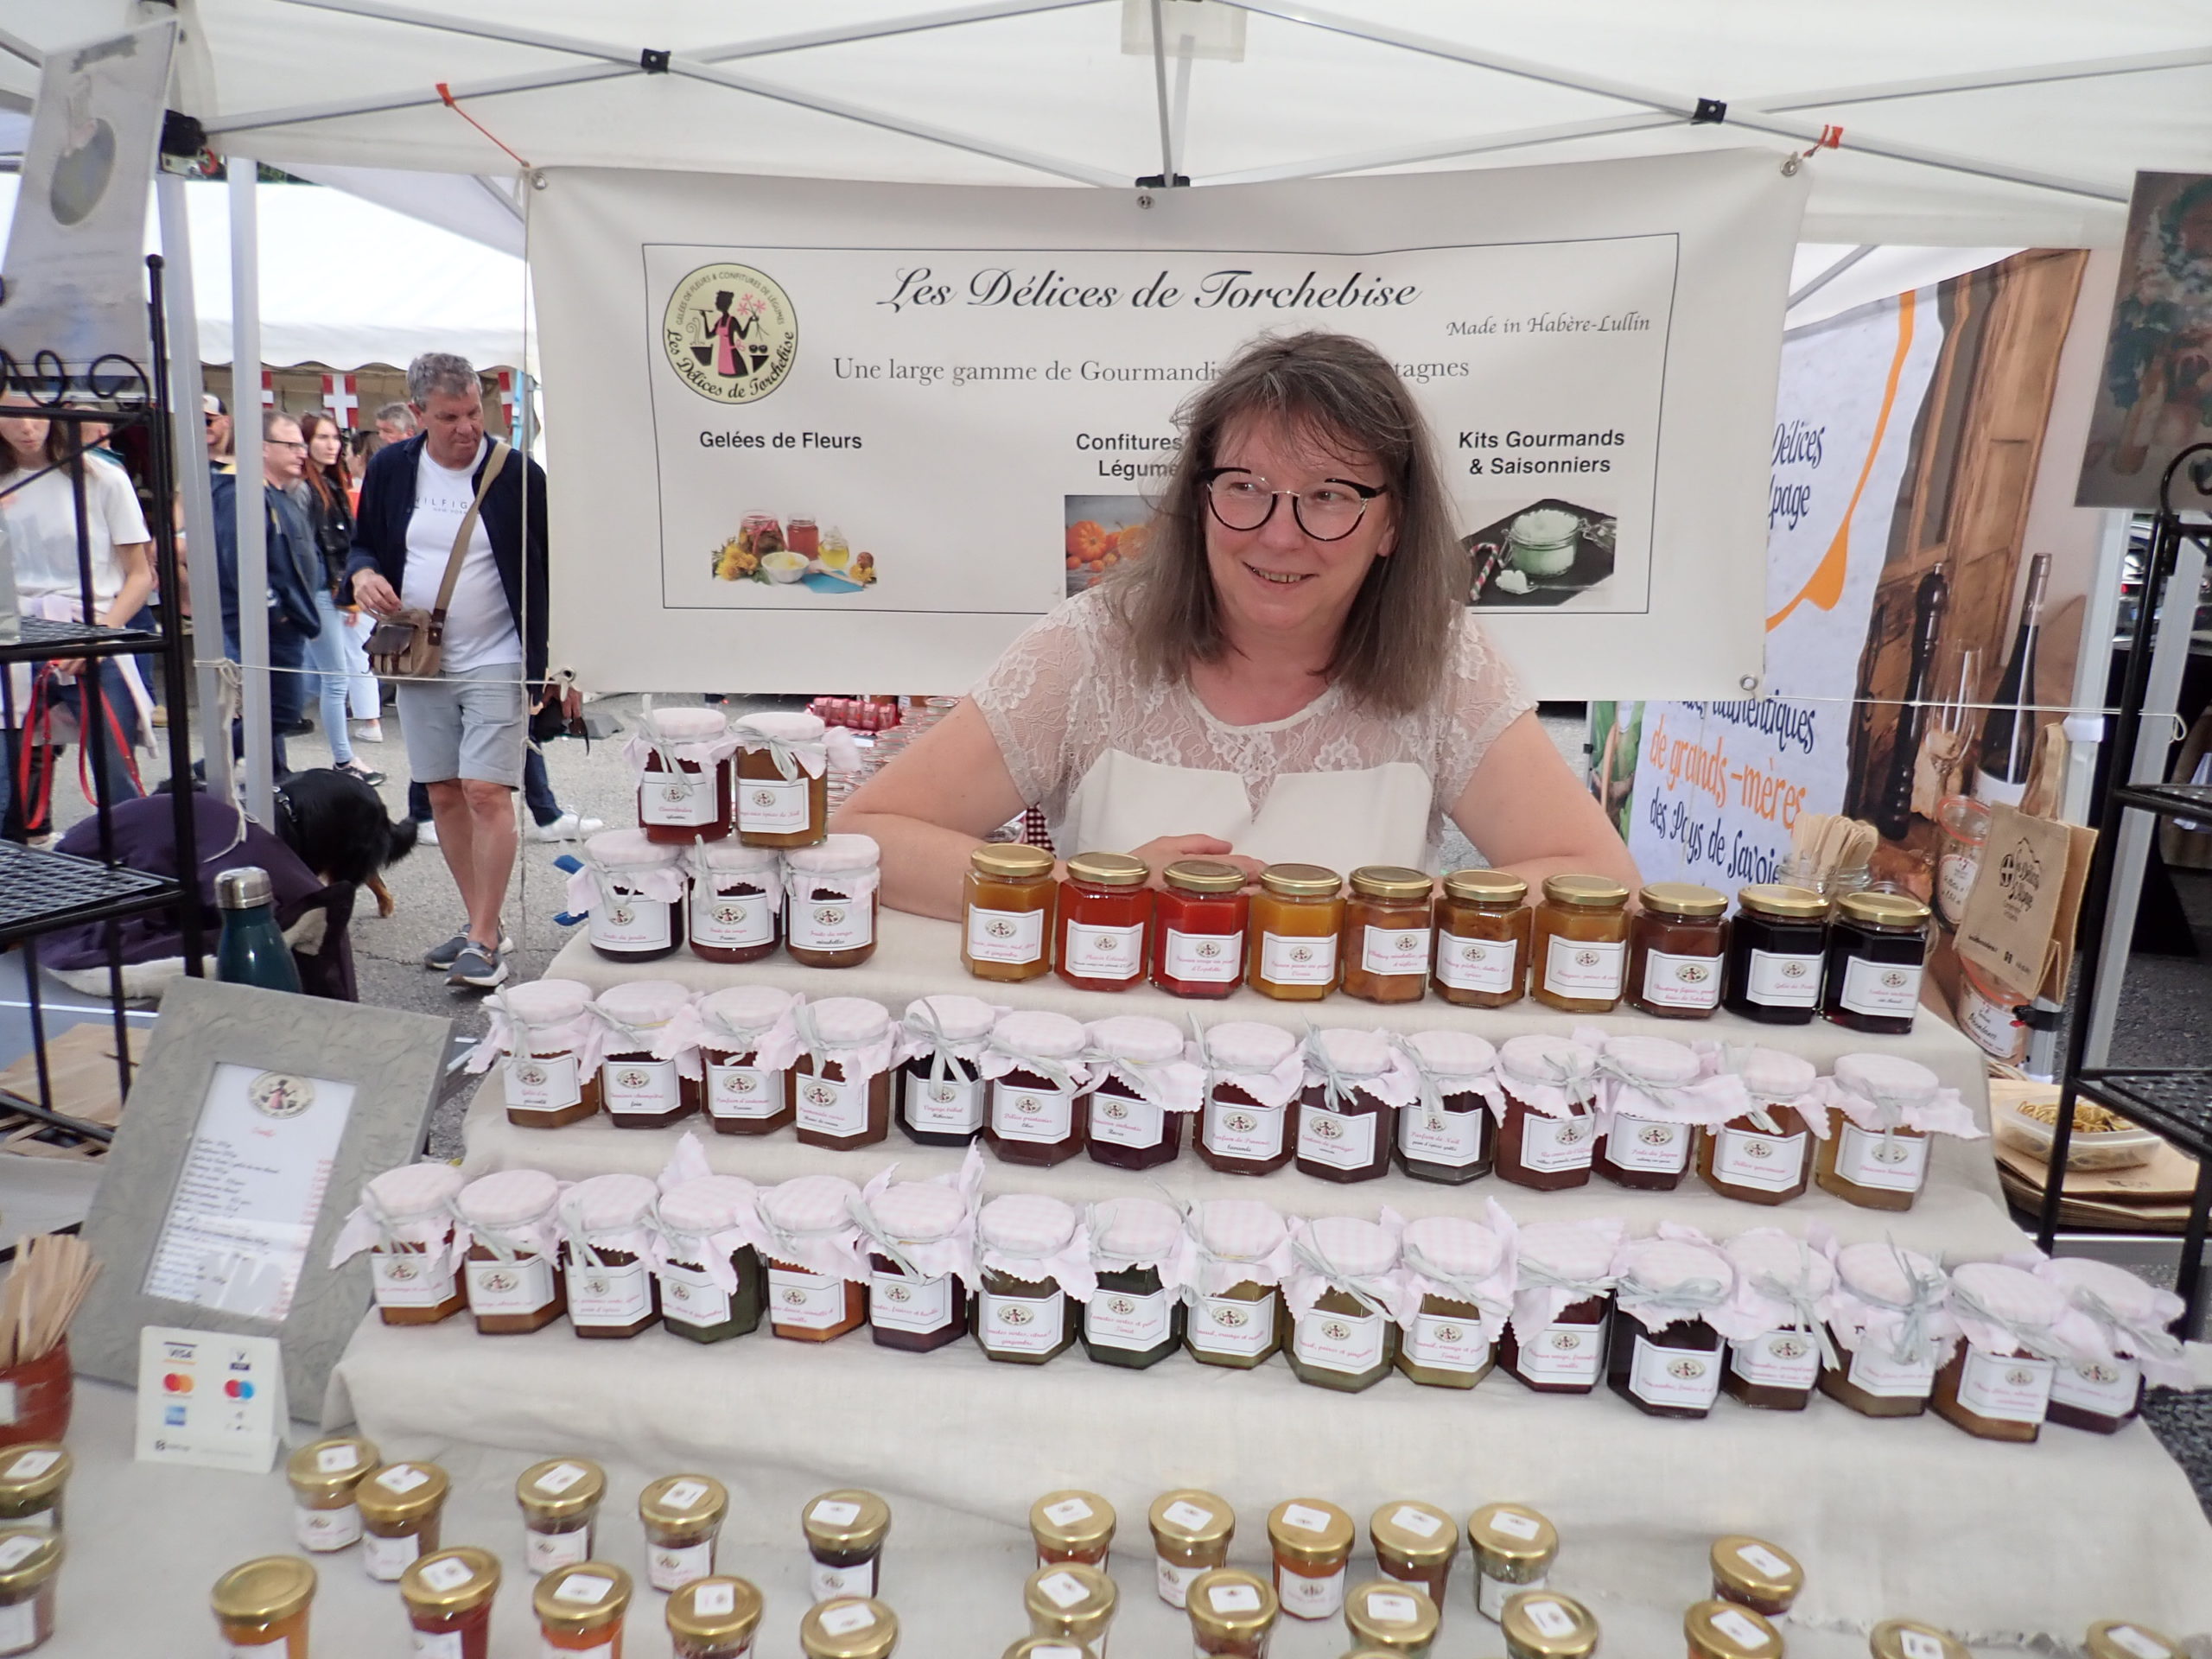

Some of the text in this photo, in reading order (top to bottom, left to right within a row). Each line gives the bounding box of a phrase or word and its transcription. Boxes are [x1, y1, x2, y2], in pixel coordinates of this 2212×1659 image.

[690, 274, 711, 296] FLEURS
[718, 271, 761, 290] CONFITURES
[876, 268, 1422, 313] Les Délices de Torchebise
[1446, 311, 1650, 336] Made in Habère-Lullin
[667, 328, 683, 356] Les
[677, 358, 723, 397] Délices
[728, 383, 746, 398] de
[834, 358, 881, 380] Une
[888, 358, 945, 387] large
[951, 367, 1037, 388] gamme
[1046, 360, 1071, 381] de
[1395, 361, 1470, 385] tagnes
[699, 430, 862, 449] Gelées de Fleurs
[1076, 433, 1182, 451] Confitures
[1459, 429, 1625, 449] Kits Gourmands
[1771, 420, 1826, 469] Délices
[1099, 459, 1179, 481] Légume
[1469, 455, 1611, 475] & Saisonniers
[1649, 714, 1667, 770] de
[1649, 786, 1667, 839] des
[1707, 817, 1726, 867] de
[168, 1347, 193, 1360] VISA
